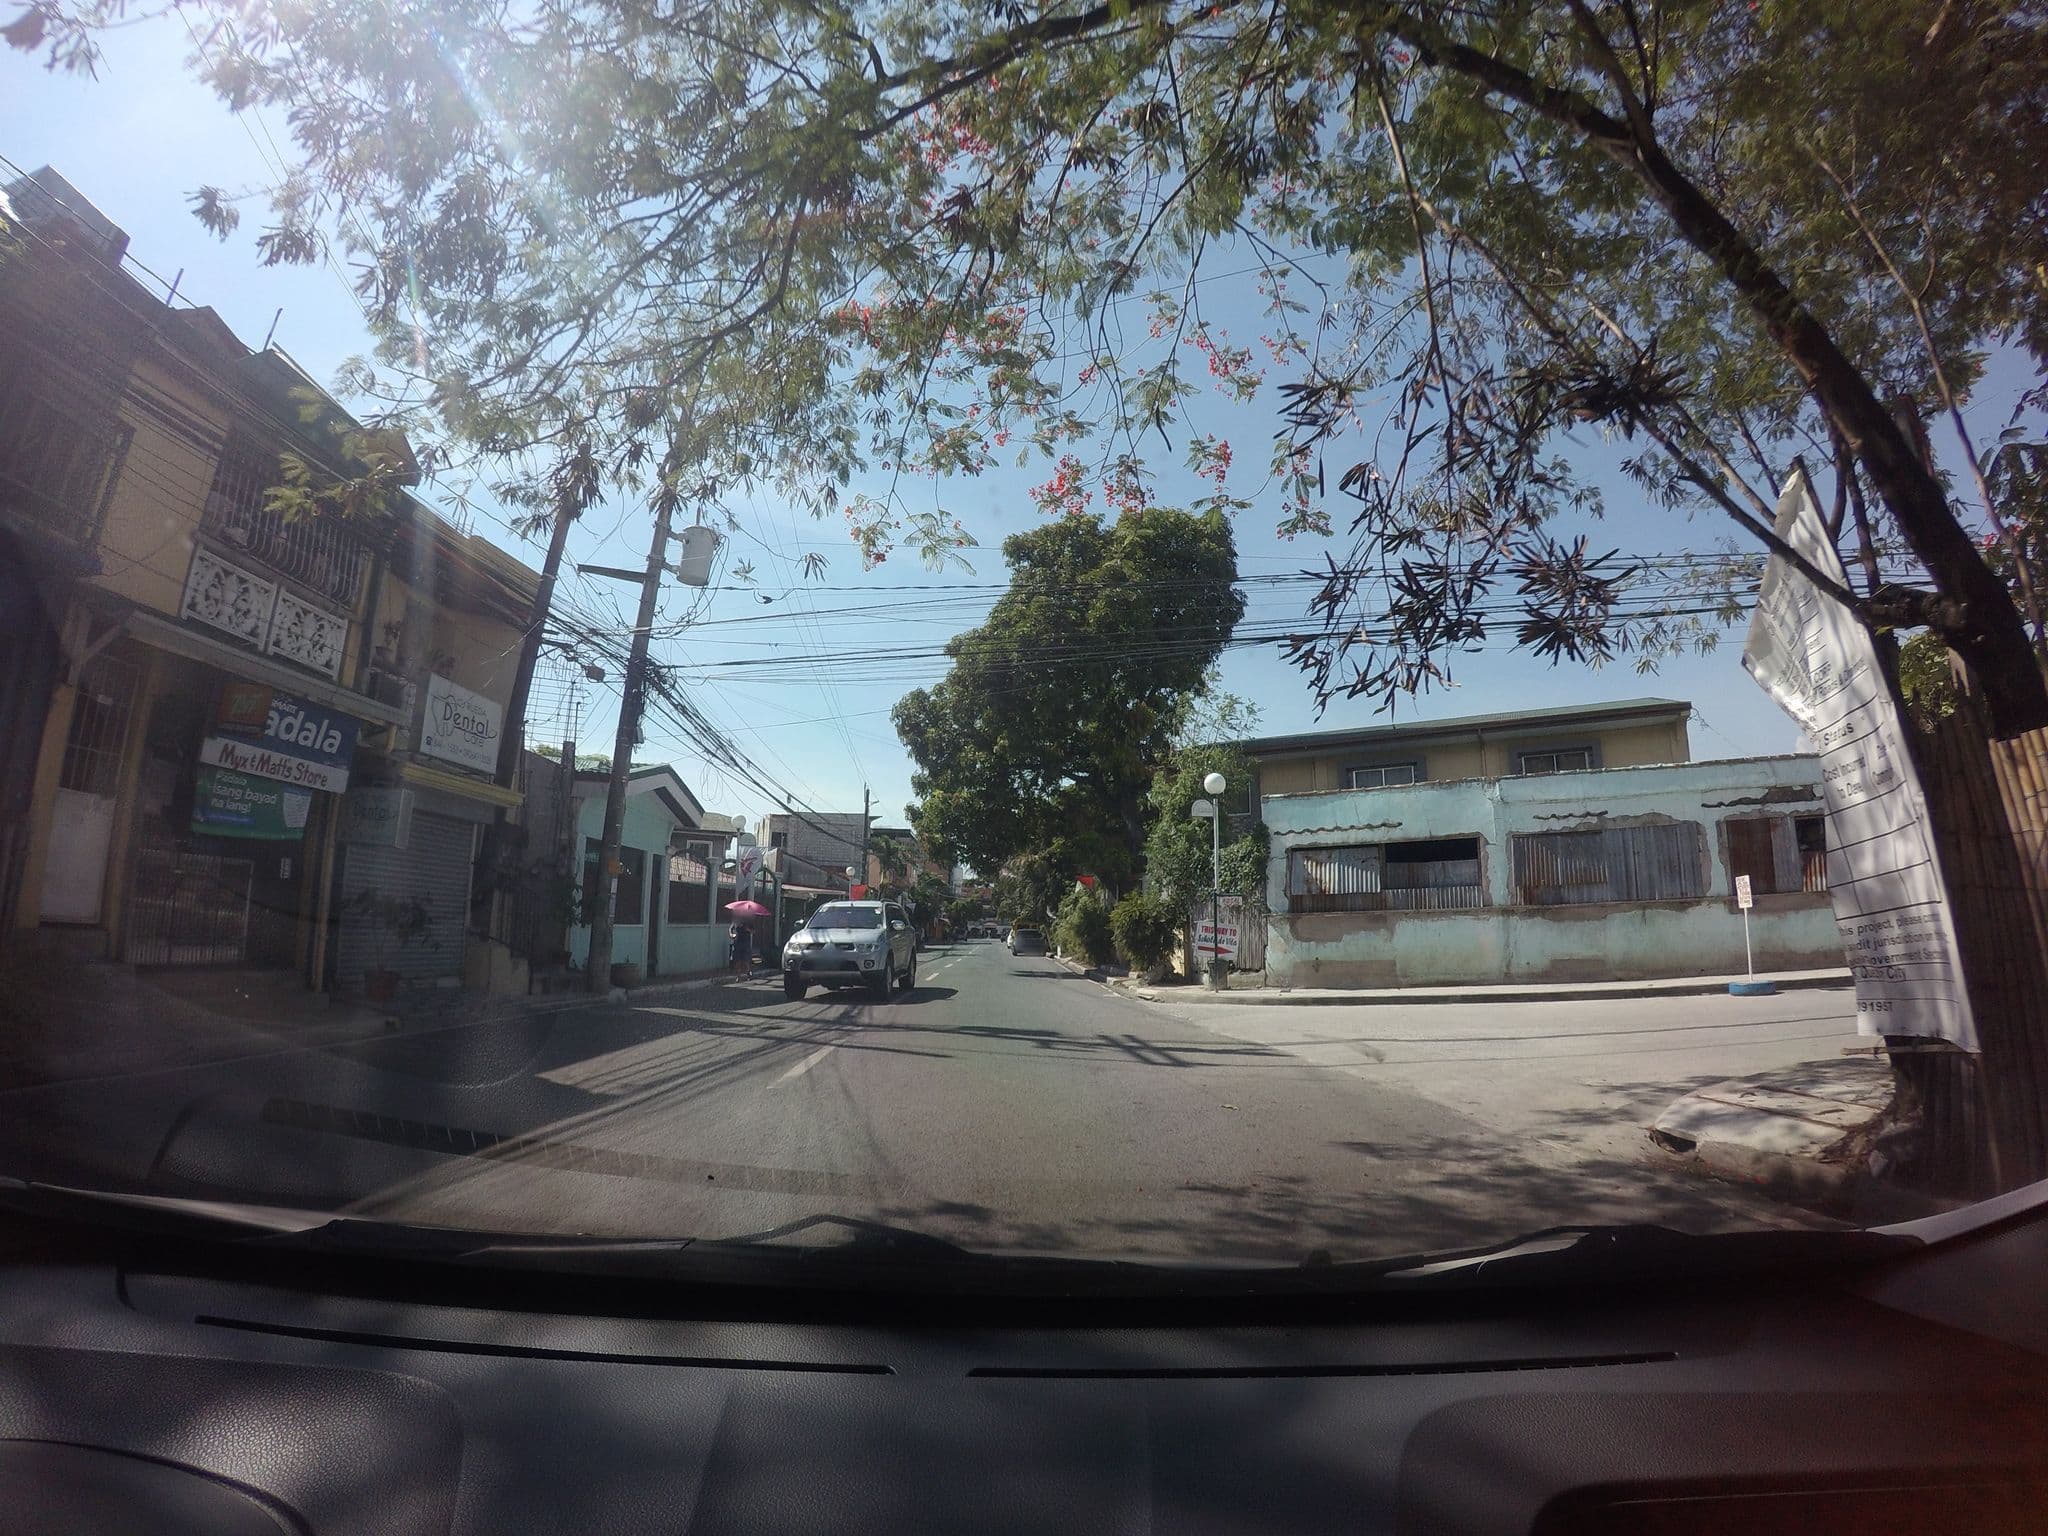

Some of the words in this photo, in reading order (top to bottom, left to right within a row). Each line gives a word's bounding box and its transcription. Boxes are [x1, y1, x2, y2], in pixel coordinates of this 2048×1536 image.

[264, 710, 343, 754] adala
[443, 701, 489, 737] Dental
[1823, 722, 1854, 746] Status
[294, 762, 329, 788] Store
[1201, 926, 1214, 934] THIS
[1229, 928, 1237, 937] TO
